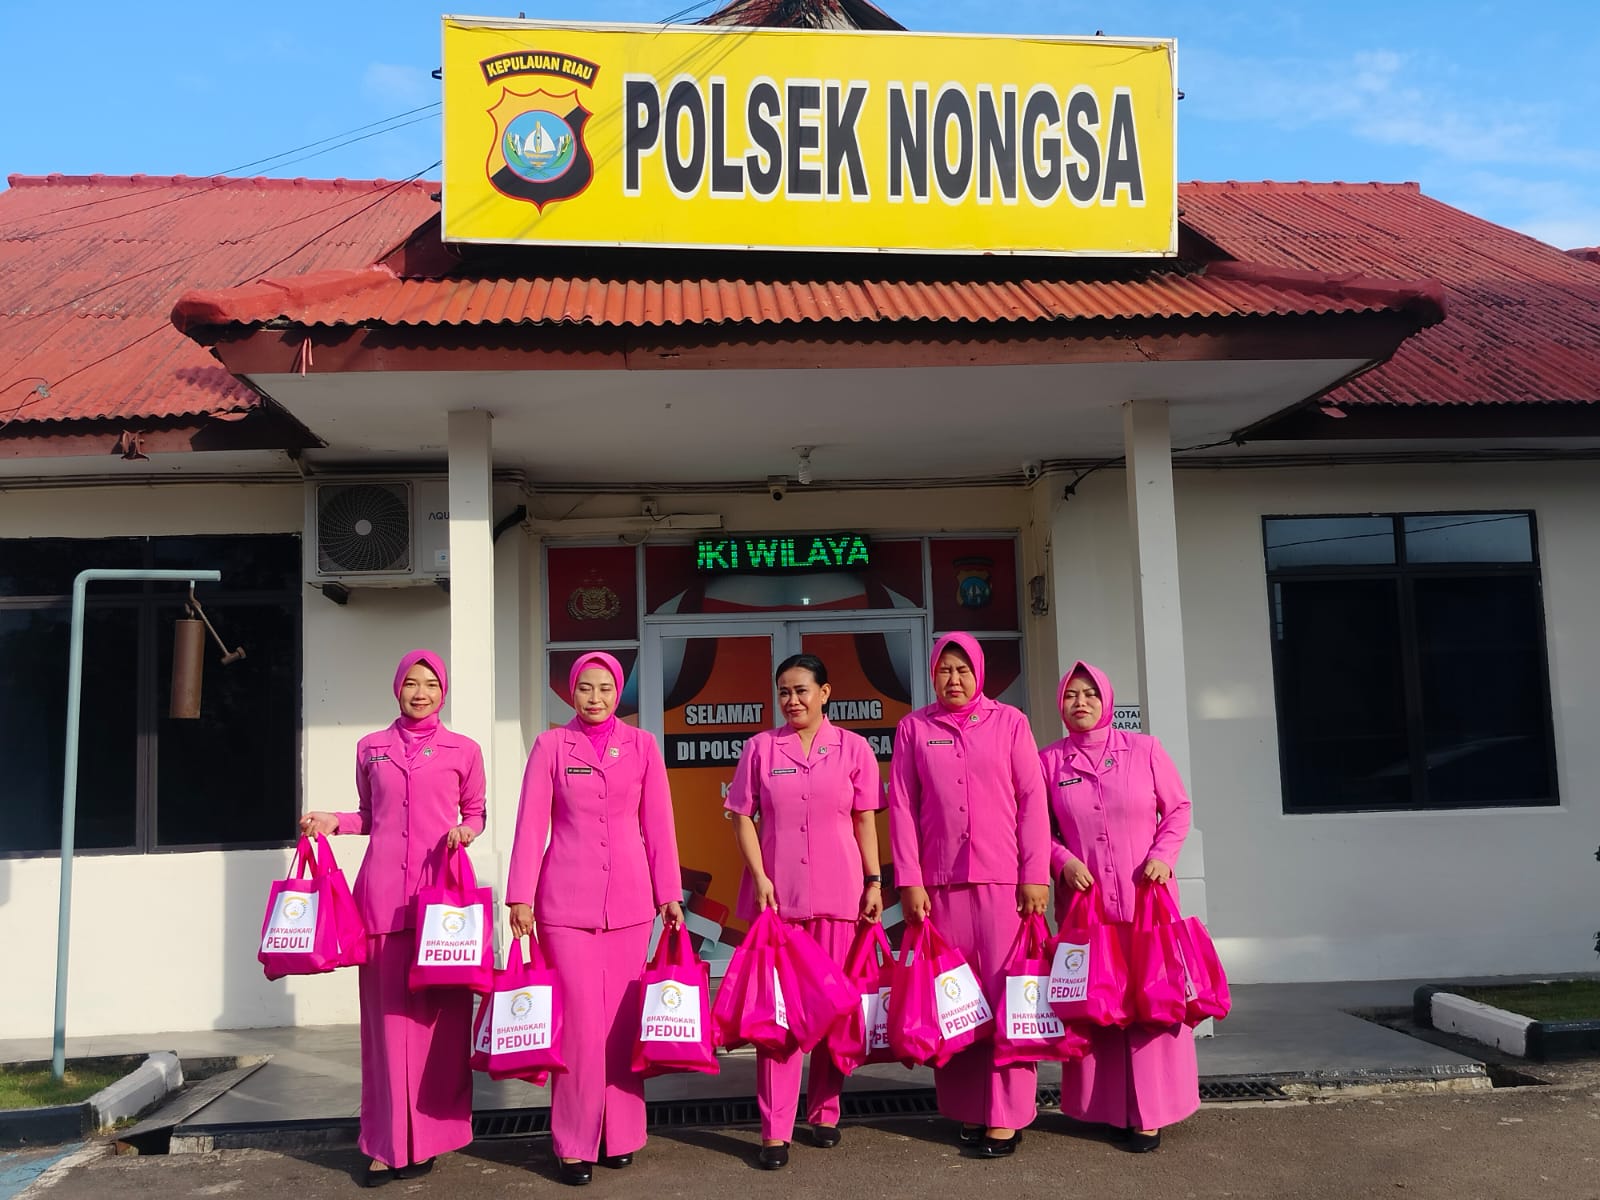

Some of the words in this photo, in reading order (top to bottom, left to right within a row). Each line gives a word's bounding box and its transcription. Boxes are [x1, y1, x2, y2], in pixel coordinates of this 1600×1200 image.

[486, 55, 560, 77] KEPULAUAN
[562, 58, 593, 80] RIAU
[626, 80, 868, 196] POLSEK
[890, 88, 1144, 202] NONGSA
[429, 511, 450, 521] AQU
[745, 536, 869, 567] WILAYA
[686, 703, 764, 725] SELAMAT
[828, 700, 882, 720] ATANG
[1113, 710, 1141, 719] KOTA
[1112, 721, 1142, 730] SARA
[677, 741, 696, 761] DI
[700, 740, 749, 760] POLS
[266, 936, 310, 949] PEDULI
[426, 939, 477, 947] BHAYANGKARI
[425, 949, 476, 961] PEDULI
[1050, 985, 1085, 999] PEDULI
[646, 1015, 696, 1025] BHAYANGKARI
[945, 1006, 989, 1034] PEDULI
[496, 1022, 546, 1035] BHAYANGKARI
[646, 1024, 695, 1038] PEDULI
[1013, 1021, 1059, 1035] PEDULI
[497, 1032, 545, 1050] PEDULI
